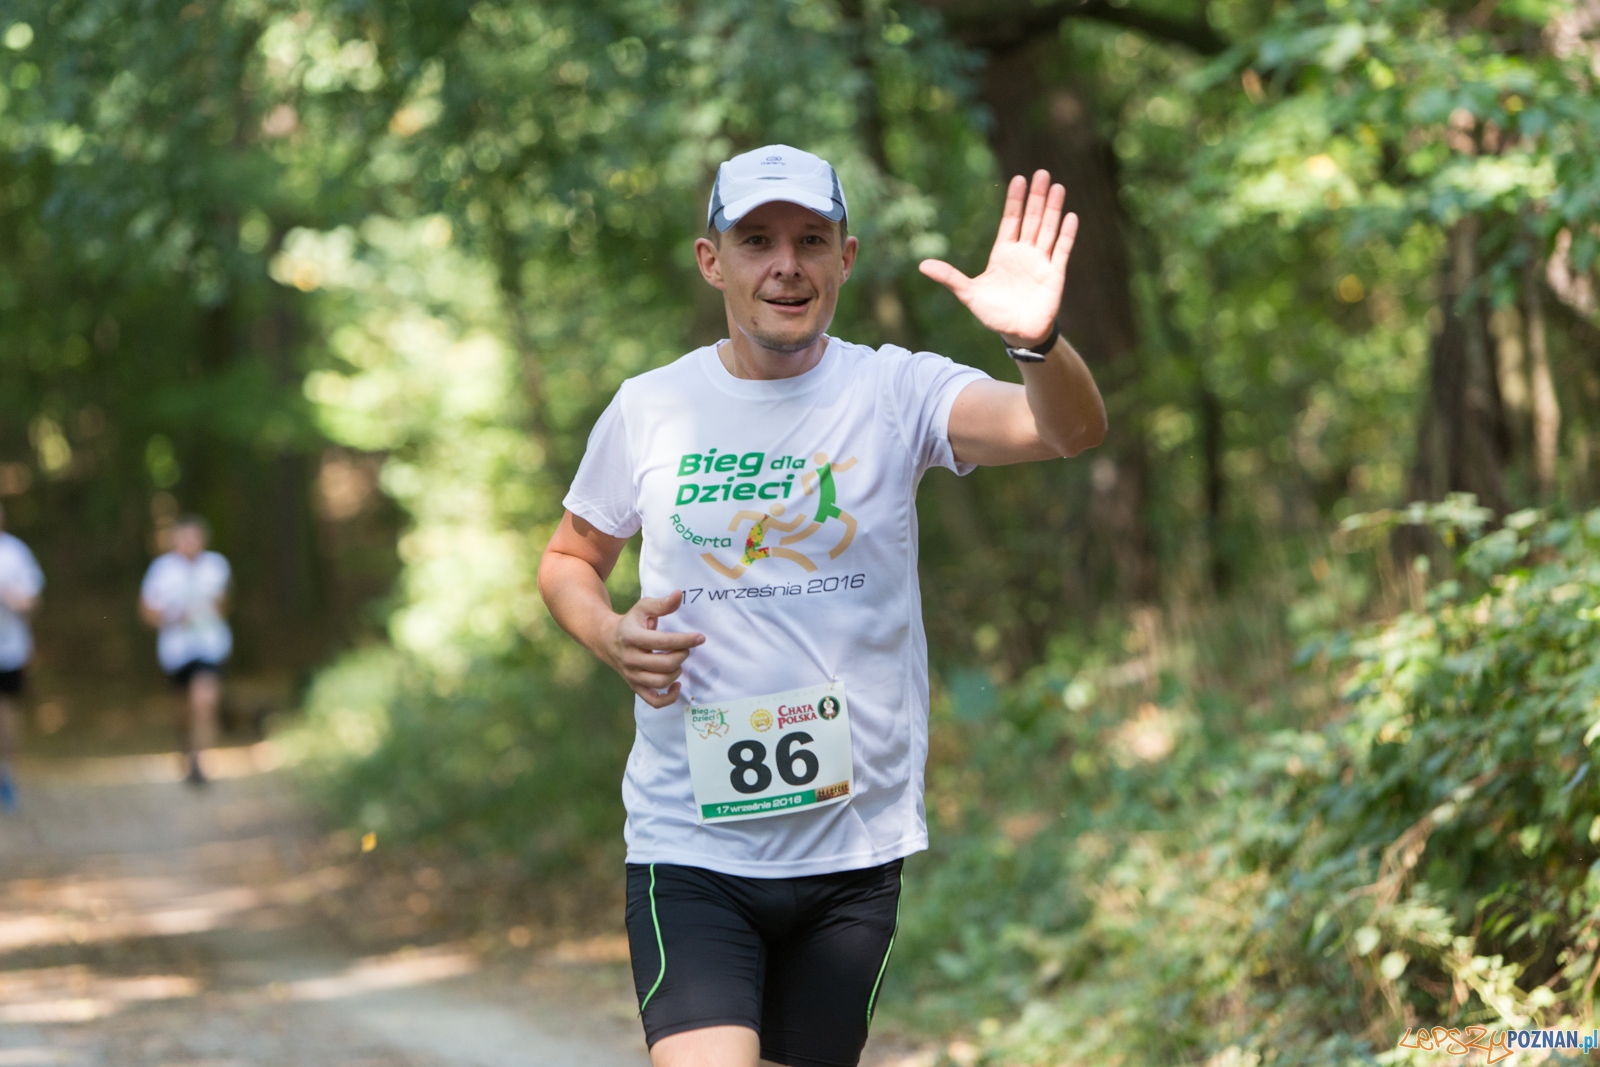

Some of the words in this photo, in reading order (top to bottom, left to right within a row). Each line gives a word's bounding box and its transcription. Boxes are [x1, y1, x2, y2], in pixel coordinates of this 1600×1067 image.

[676, 448, 765, 477] Bieg
[770, 456, 806, 470] dla
[675, 474, 795, 506] Dzieci
[669, 513, 732, 548] Roberta
[681, 588, 703, 605] 17
[708, 582, 802, 601] września
[807, 573, 866, 594] 2016
[727, 731, 819, 794] 86
[716, 805, 729, 814] 17
